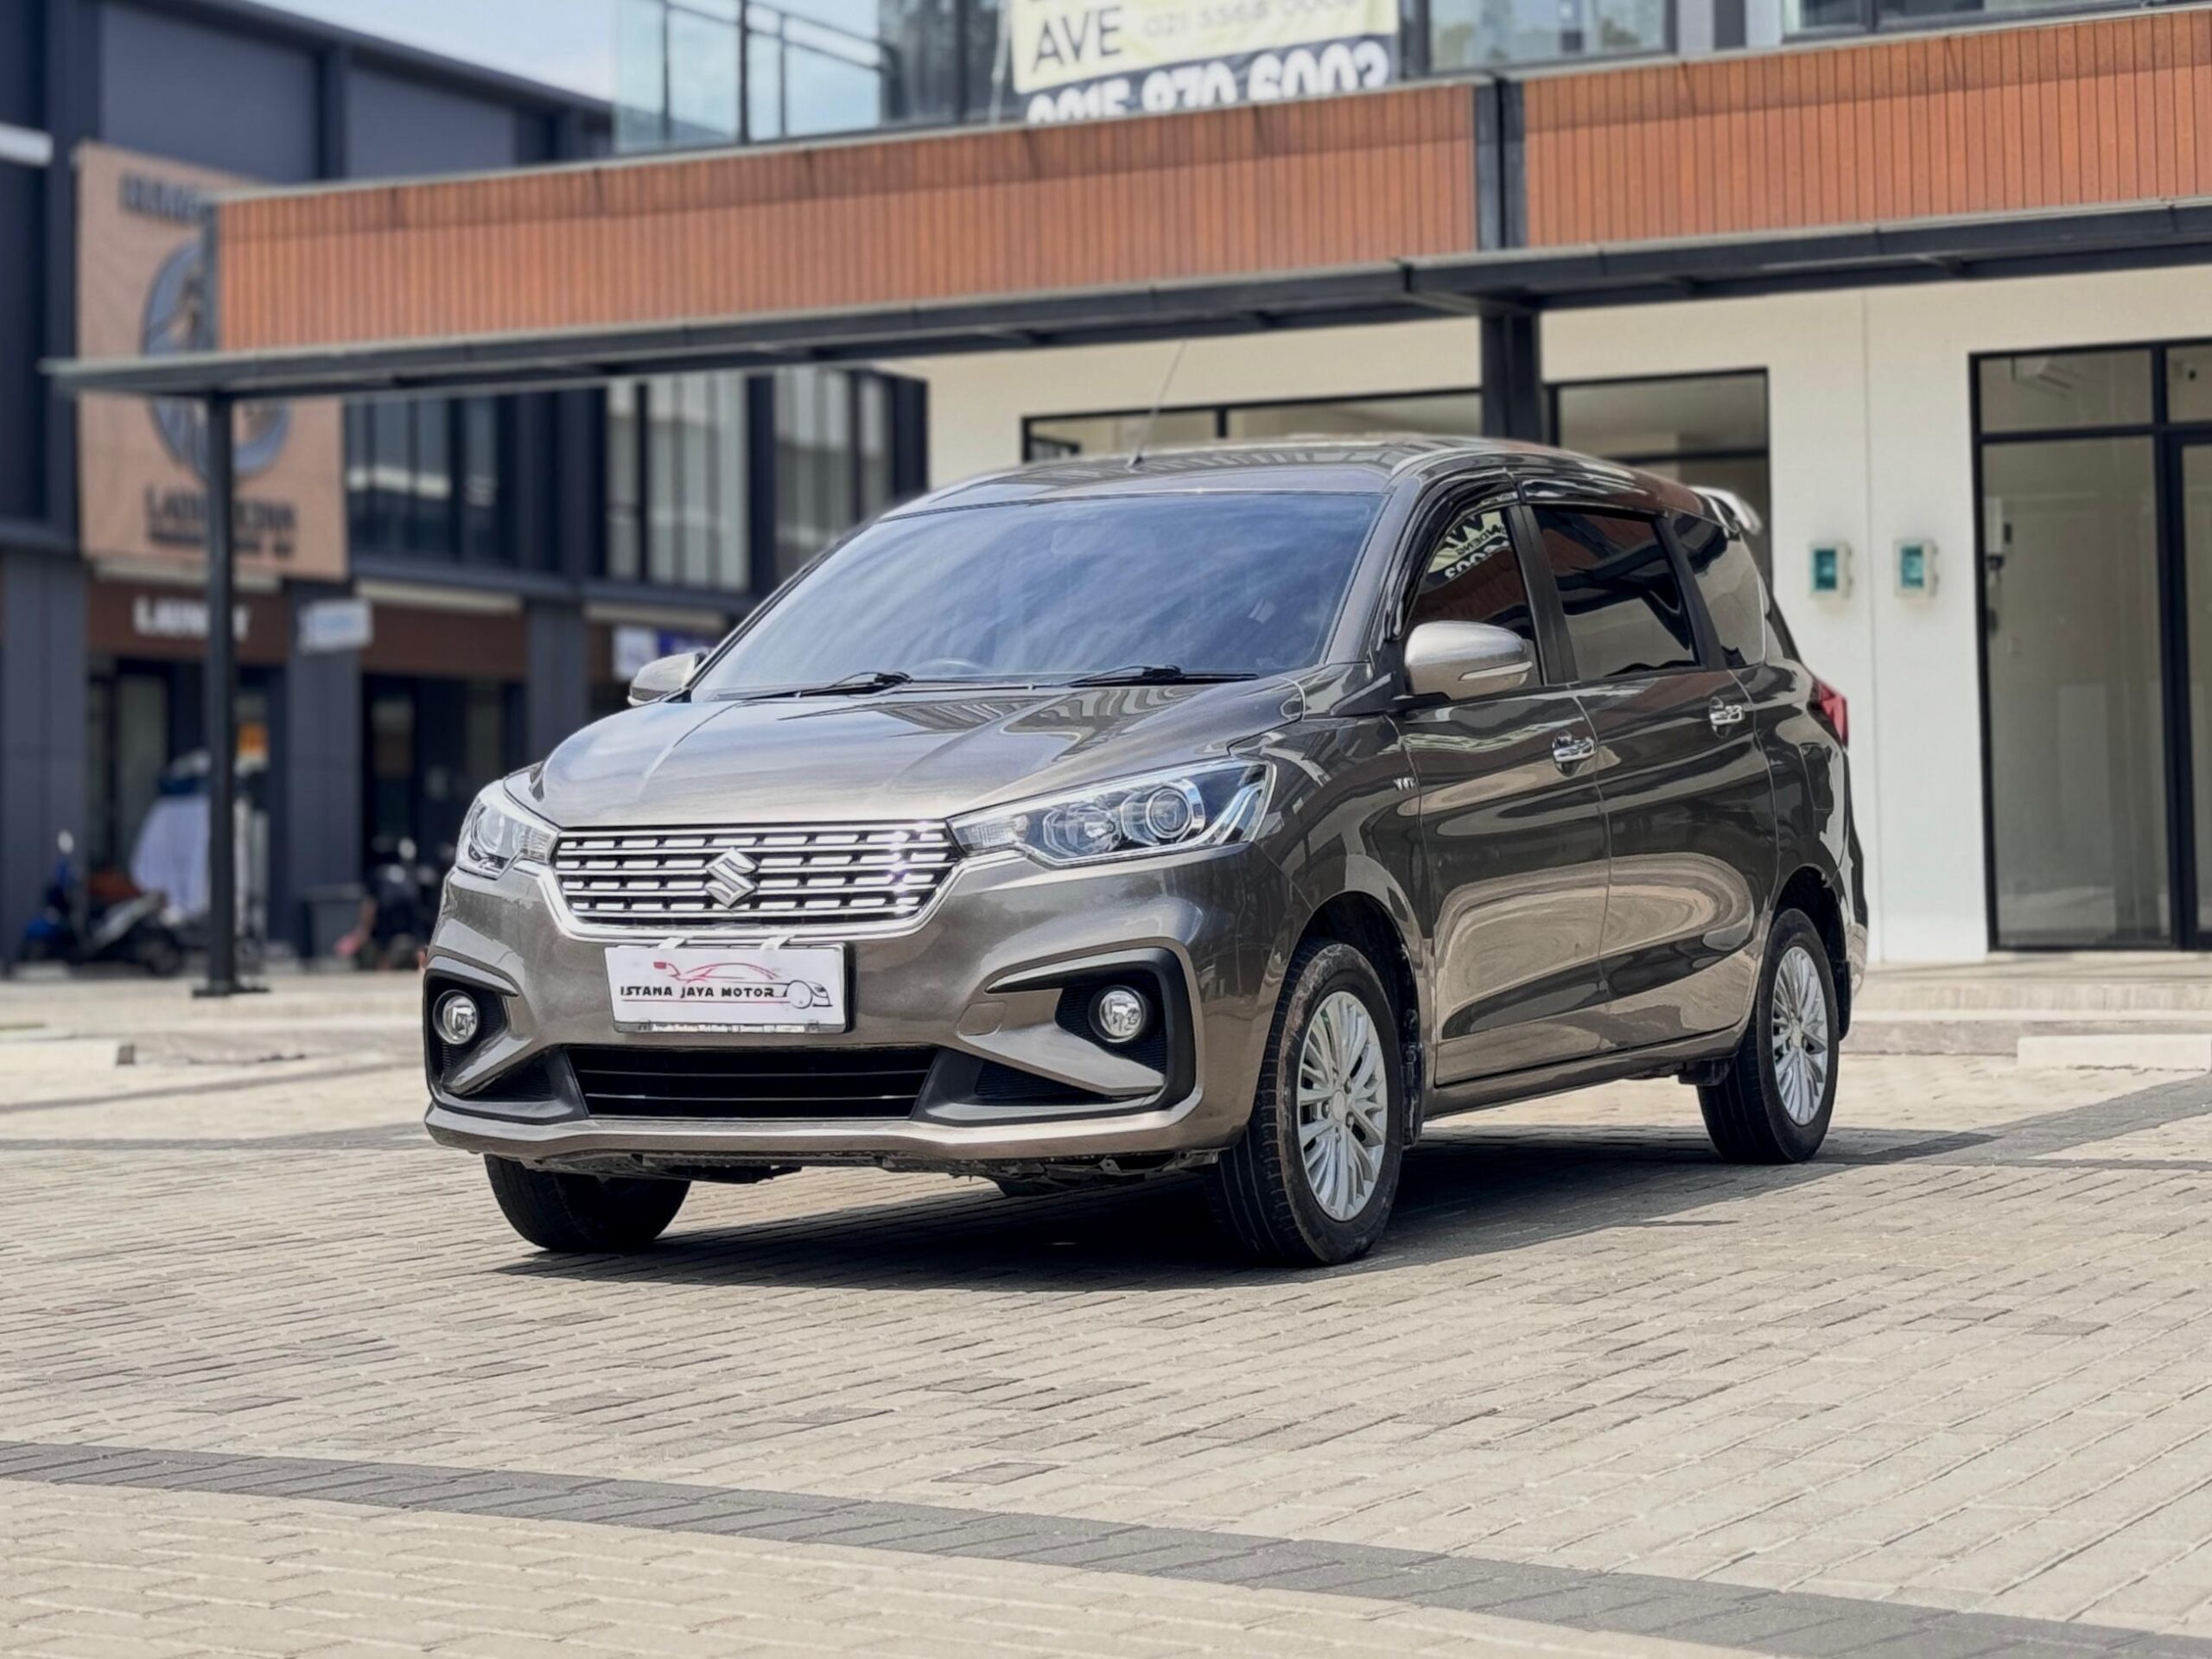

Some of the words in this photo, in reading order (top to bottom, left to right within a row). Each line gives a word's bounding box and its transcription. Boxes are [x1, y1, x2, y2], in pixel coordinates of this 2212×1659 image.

[1033, 7, 1122, 73] AVE
[620, 986, 672, 996] ISTANA
[680, 986, 715, 998] JAYA
[721, 987, 775, 998] MOTOR
